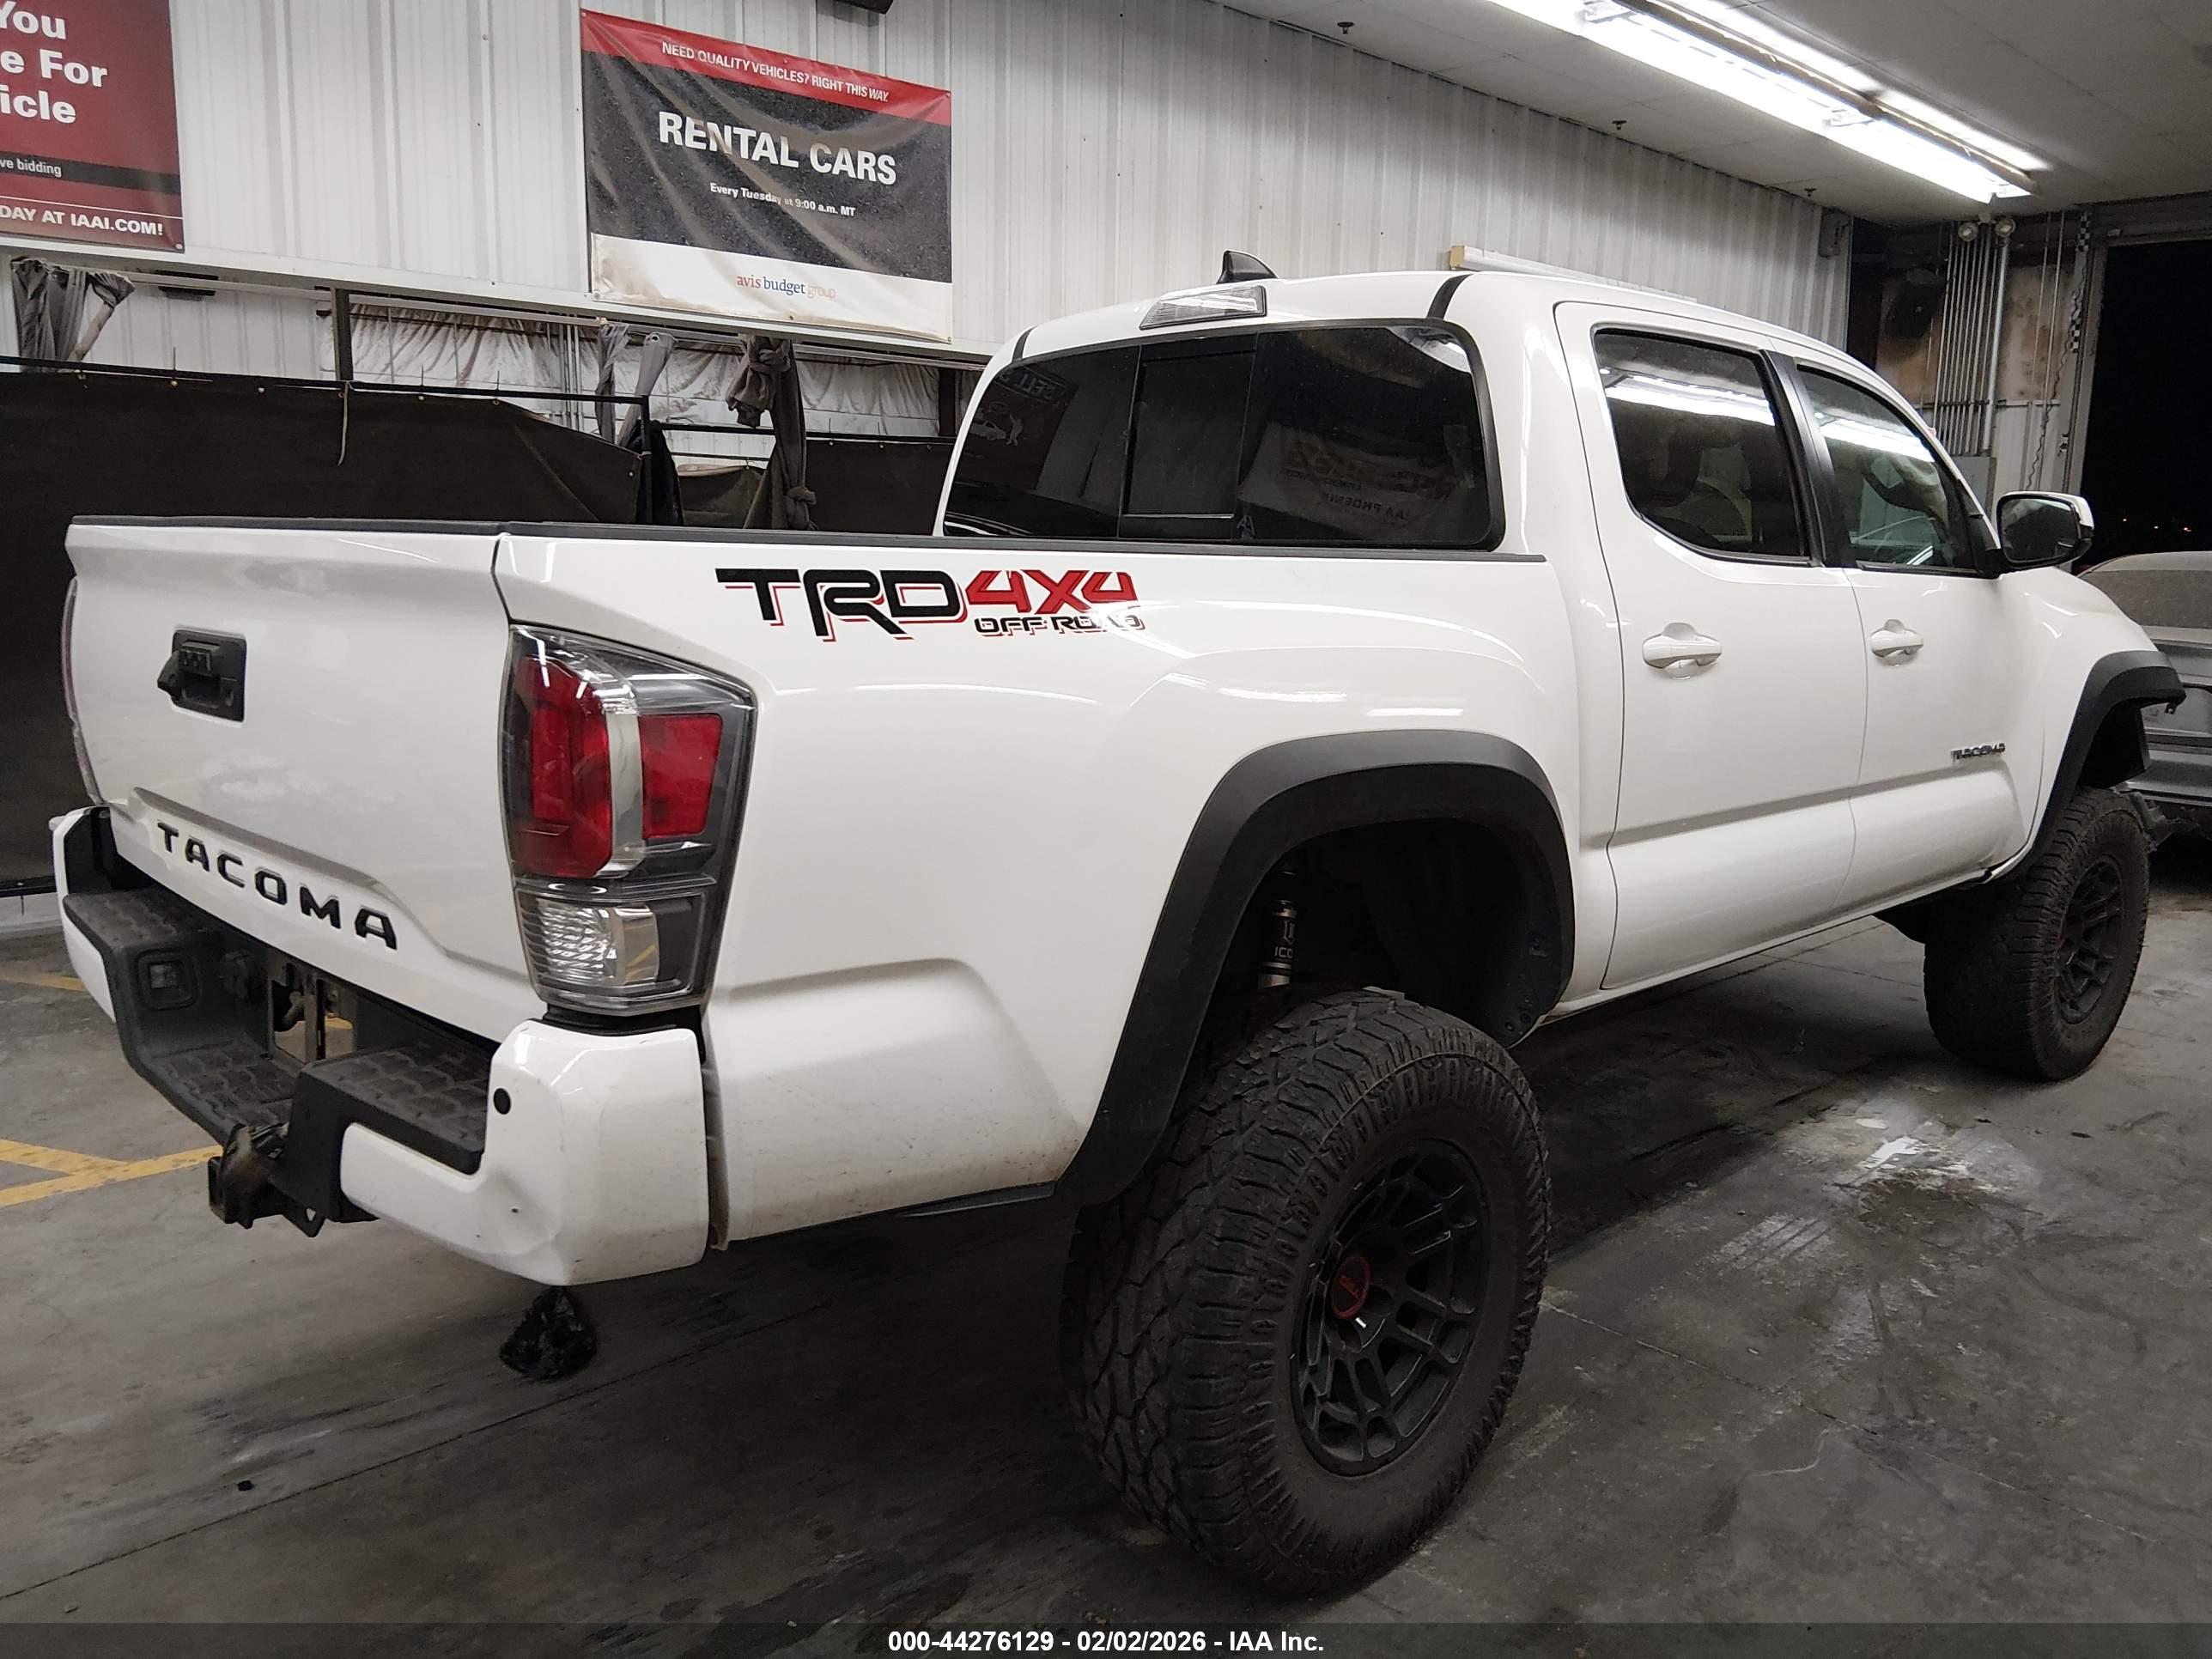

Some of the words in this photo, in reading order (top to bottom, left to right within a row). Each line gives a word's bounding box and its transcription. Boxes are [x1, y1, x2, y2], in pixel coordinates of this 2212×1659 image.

[0, 1, 67, 40] You
[40, 49, 108, 88] For
[662, 42, 695, 59] NEED
[697, 50, 750, 71] QUALITY
[751, 61, 810, 84] VEHICLES?
[811, 76, 844, 92] RIGHT
[845, 82, 867, 98] THIS
[868, 88, 889, 102] WAY.
[659, 111, 799, 168] RENTAL
[810, 143, 896, 185] CARS
[16, 158, 62, 178] bidding
[710, 183, 738, 198] Every
[740, 187, 781, 205] Tuesday
[783, 196, 793, 206] at
[794, 198, 816, 210] 9:00
[817, 204, 838, 214] a.m.
[840, 205, 856, 216] MT
[41, 210, 65, 224] AT
[70, 214, 163, 236] IAAI.COM!
[737, 275, 762, 289] avis
[763, 276, 806, 295] budget
[807, 284, 838, 300] group
[715, 567, 968, 642] TRD
[974, 616, 1047, 637] OFF
[157, 819, 398, 951] TACOMA
